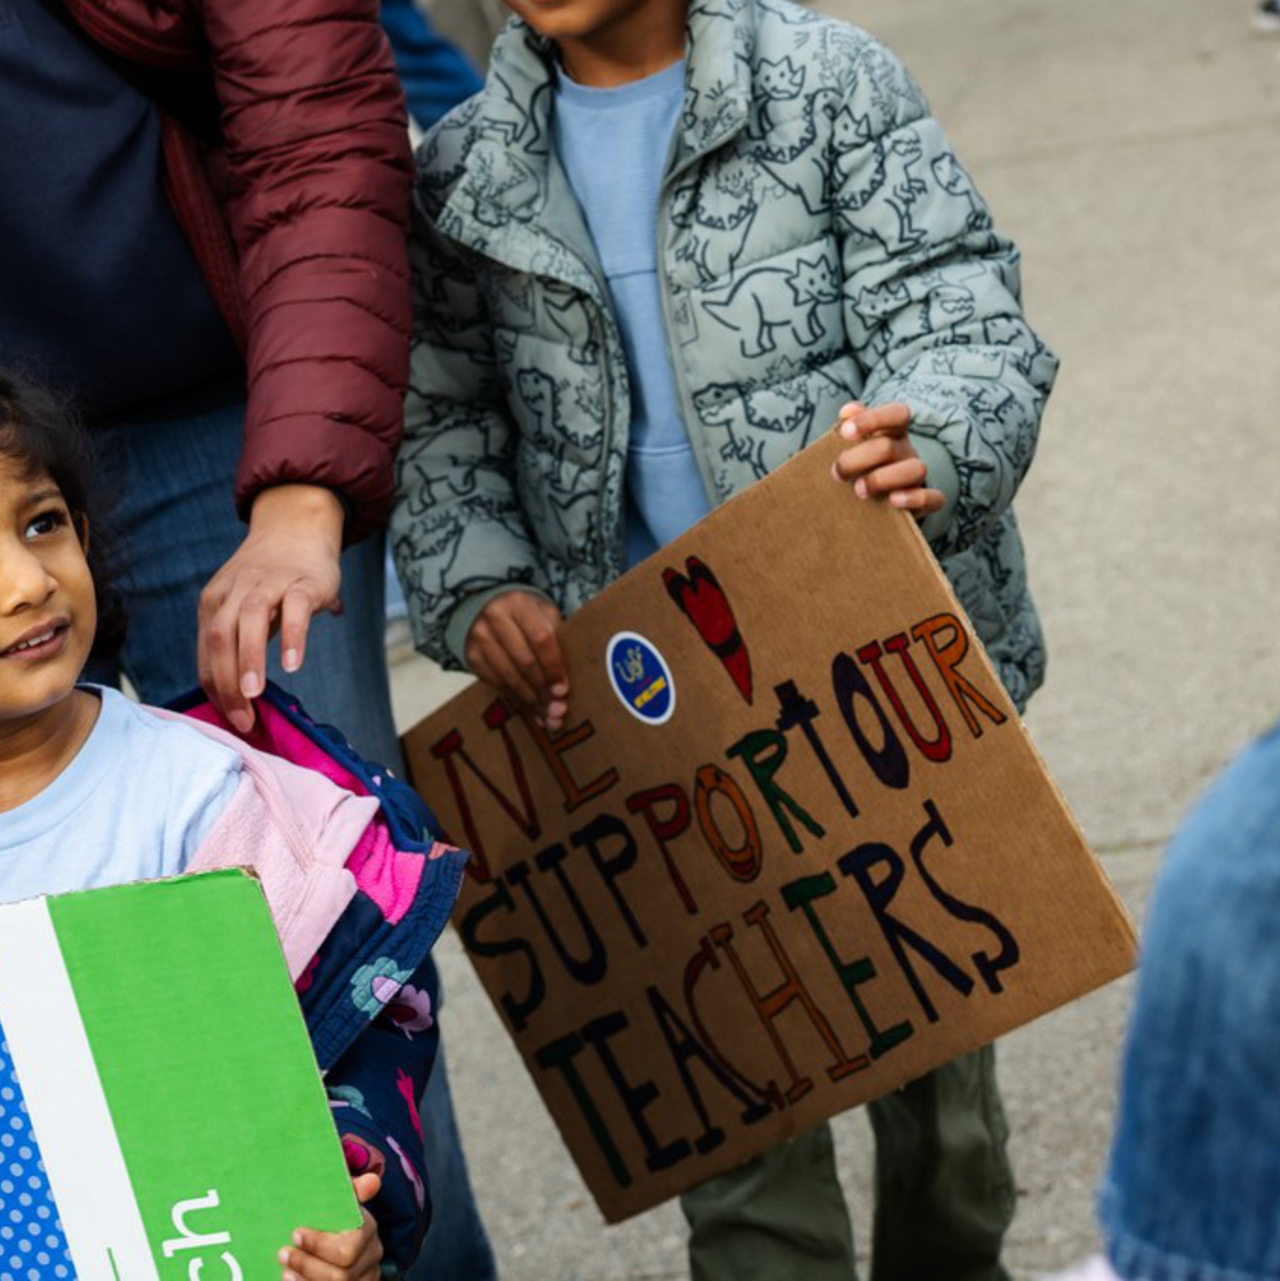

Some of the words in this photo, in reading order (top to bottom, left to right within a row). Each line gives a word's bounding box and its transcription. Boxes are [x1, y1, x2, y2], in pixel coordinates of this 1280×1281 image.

[430, 696, 620, 884] WE
[460, 679, 860, 1033] SUPPORT
[831, 612, 1008, 789] OUR
[535, 798, 1020, 1189] TEACHERS
